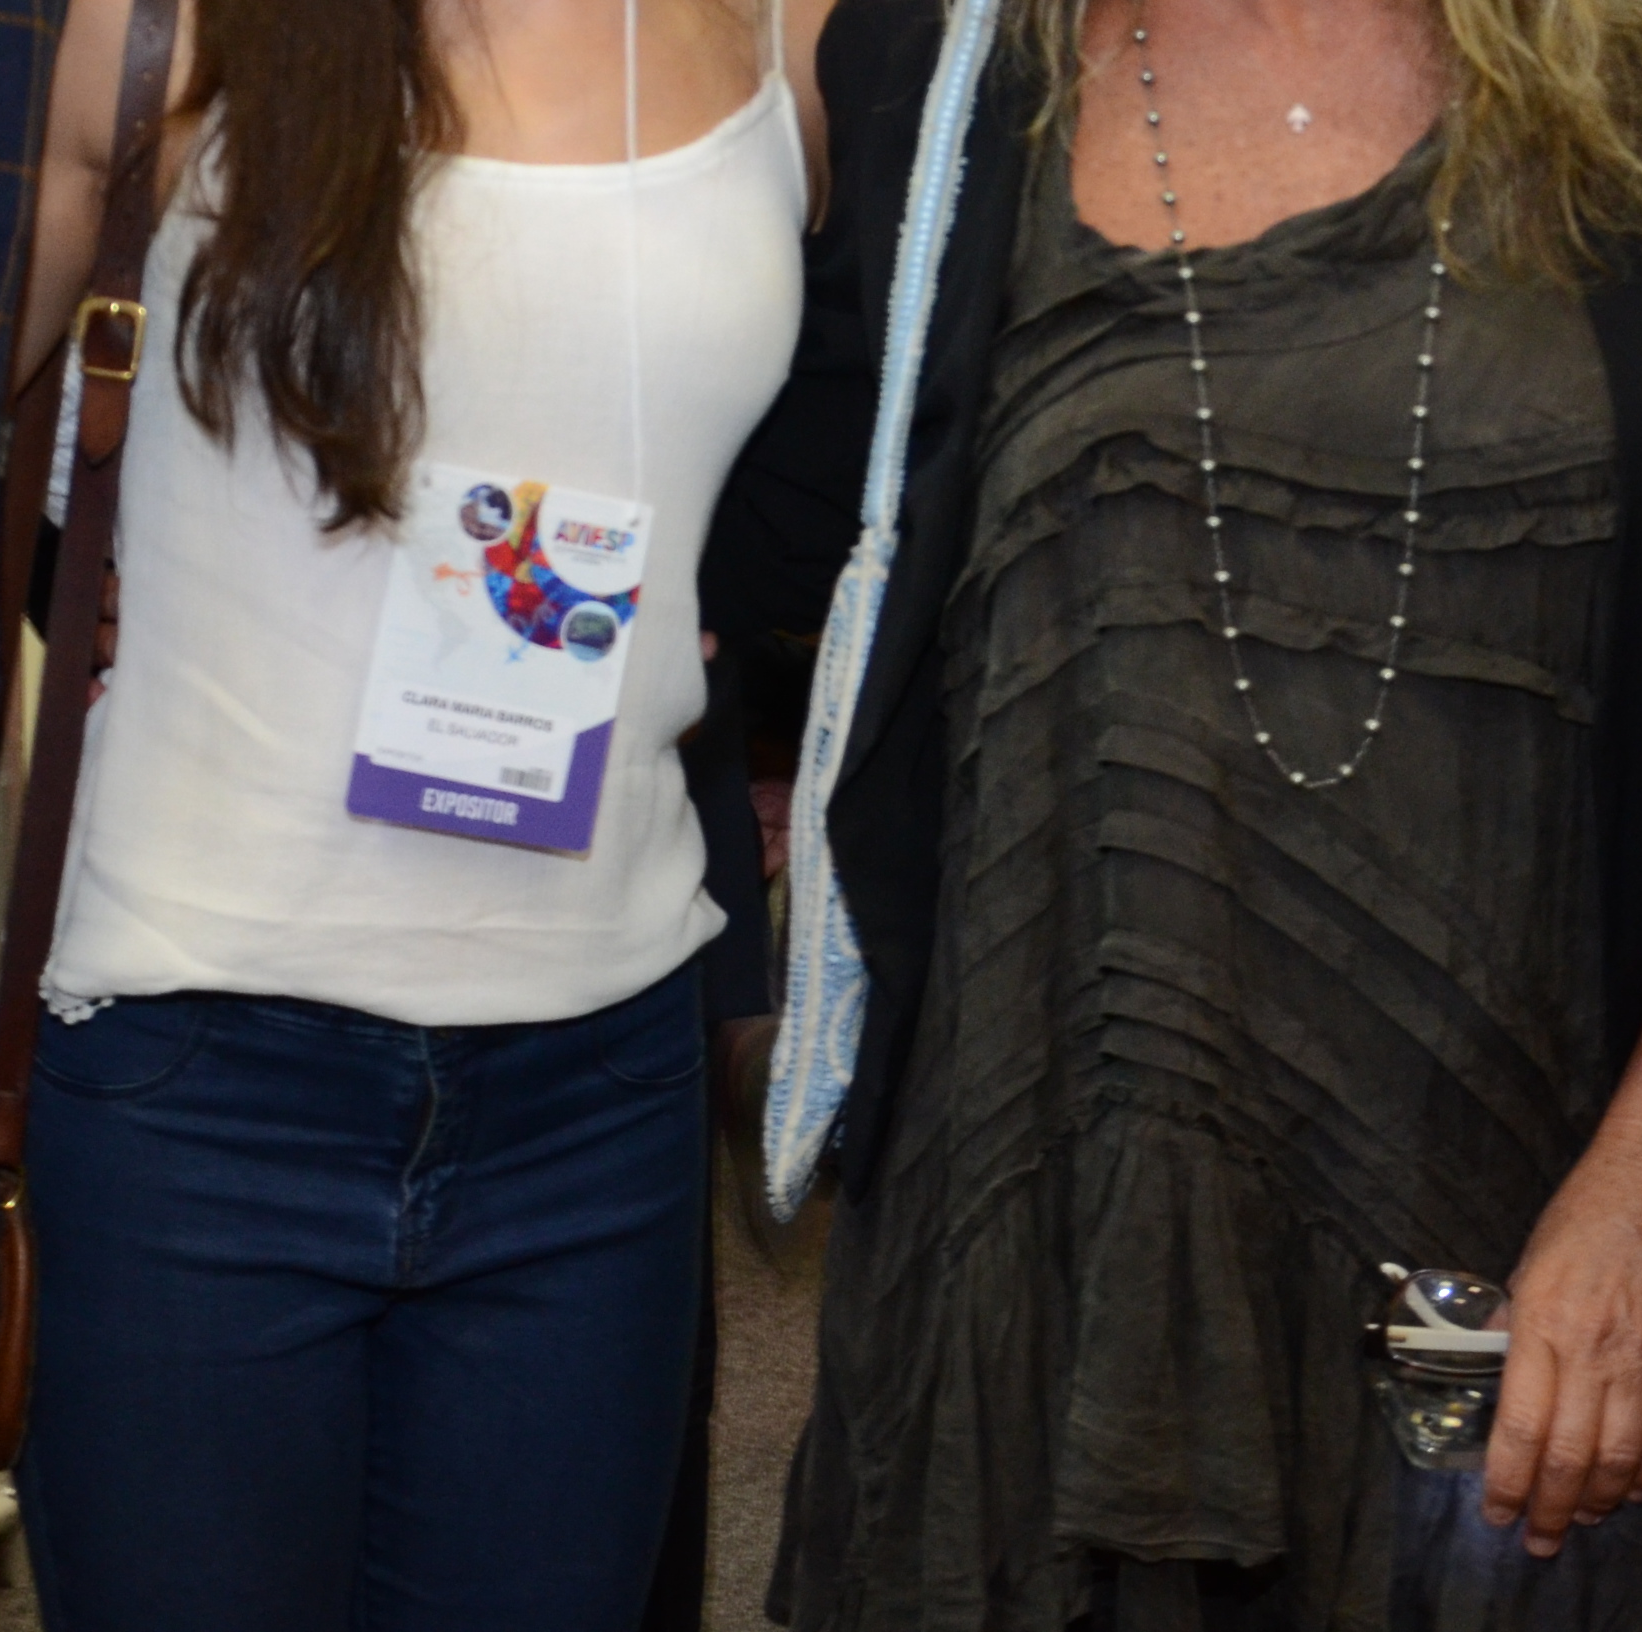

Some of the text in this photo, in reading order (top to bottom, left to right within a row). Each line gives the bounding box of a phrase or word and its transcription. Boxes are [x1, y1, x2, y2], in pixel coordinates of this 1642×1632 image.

[402, 690, 447, 711] CLARA
[450, 700, 493, 720] MARIA
[427, 718, 519, 747] EL SALVADOR
[421, 787, 520, 827] EXPOSITOR
